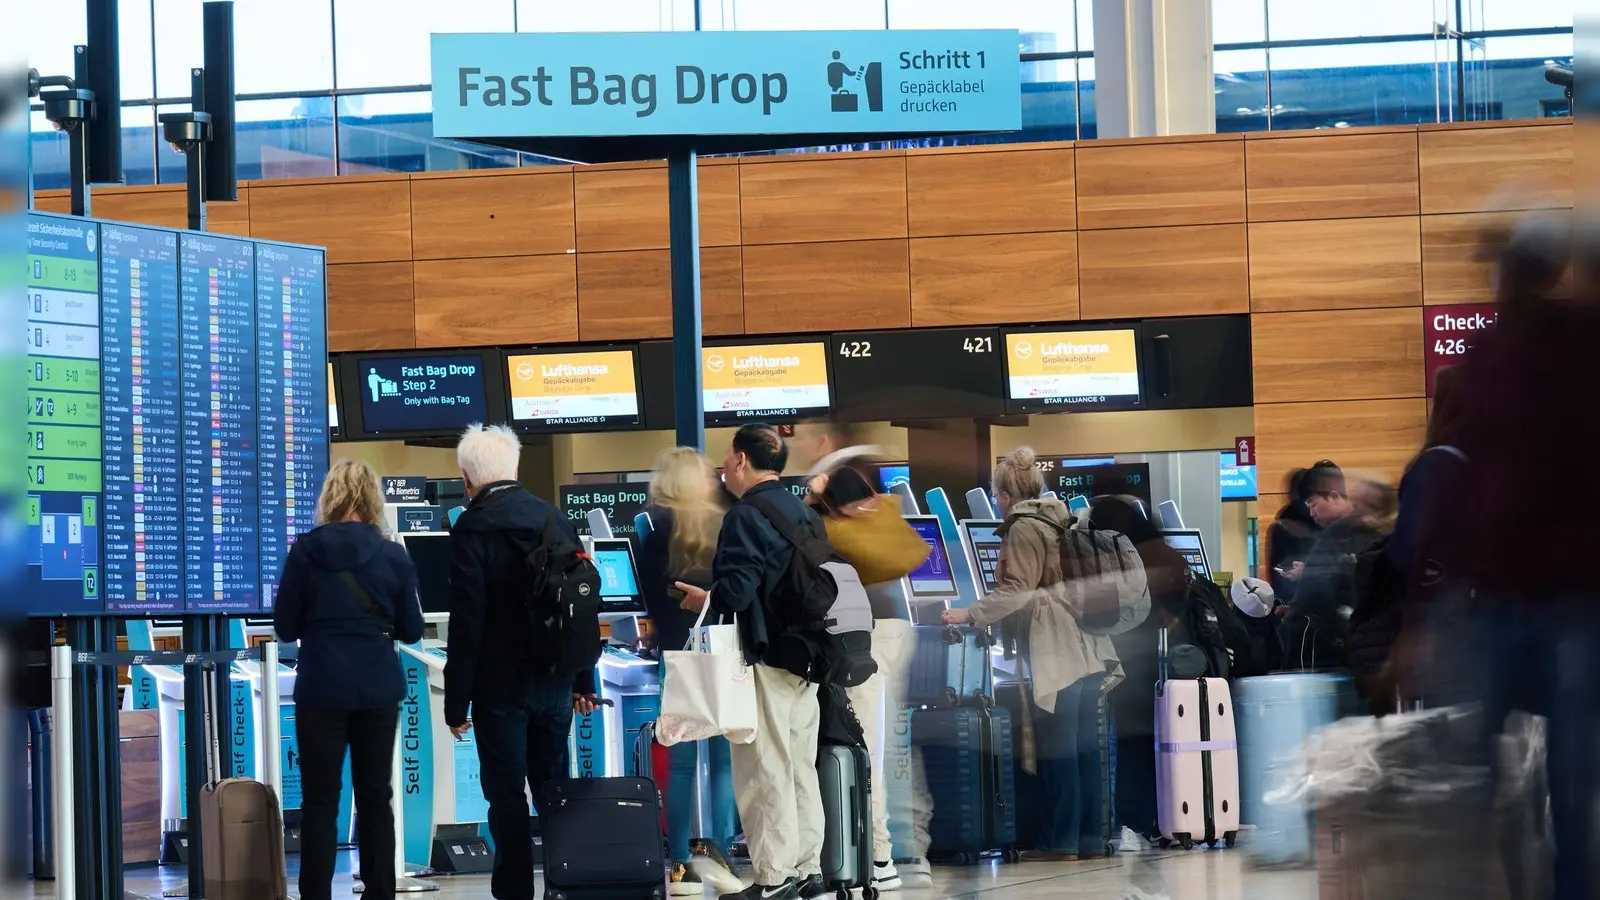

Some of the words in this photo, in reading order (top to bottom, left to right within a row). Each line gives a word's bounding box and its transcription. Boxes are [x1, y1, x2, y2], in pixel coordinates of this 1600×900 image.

[899, 50, 971, 70] Schritt
[976, 50, 985, 69] 1
[459, 67, 553, 107] Fast
[570, 66, 657, 118] Bag
[676, 65, 788, 116] Drop
[900, 79, 985, 97] Gepäcklabel
[900, 98, 958, 112] drucken
[1433, 312, 1498, 331] Check-i
[840, 341, 872, 358] 422
[963, 336, 993, 353] 421
[1041, 341, 1109, 355] Lufthansa
[732, 355, 800, 369] Lufthansa
[401, 366, 424, 377] Fast
[426, 365, 447, 378] Bag
[449, 364, 476, 377] Drop
[541, 363, 609, 377] Lufthansa
[403, 380, 427, 393] Step
[429, 379, 436, 390] 2
[404, 397, 422, 407] Only
[423, 395, 440, 405] with
[440, 395, 456, 406] Bag
[456, 395, 471, 405] Tag
[1063, 395, 1098, 403] ALLIANCE
[755, 408, 790, 416] ALLIANCE
[546, 417, 563, 425] STAR
[564, 416, 599, 424] ALLIANCE
[397, 479, 406, 487] BER
[1059, 475, 1083, 486] Fast
[791, 484, 812, 496] Dro
[566, 493, 591, 505] Fast
[593, 492, 615, 506] Bag
[618, 491, 647, 504] Drop
[608, 507, 614, 518] 2
[77, 652, 88, 662] BER
[404, 667, 419, 751] Check-in
[234, 751, 245, 778] elf
[893, 742, 909, 780] Self
[404, 757, 419, 795] Self
